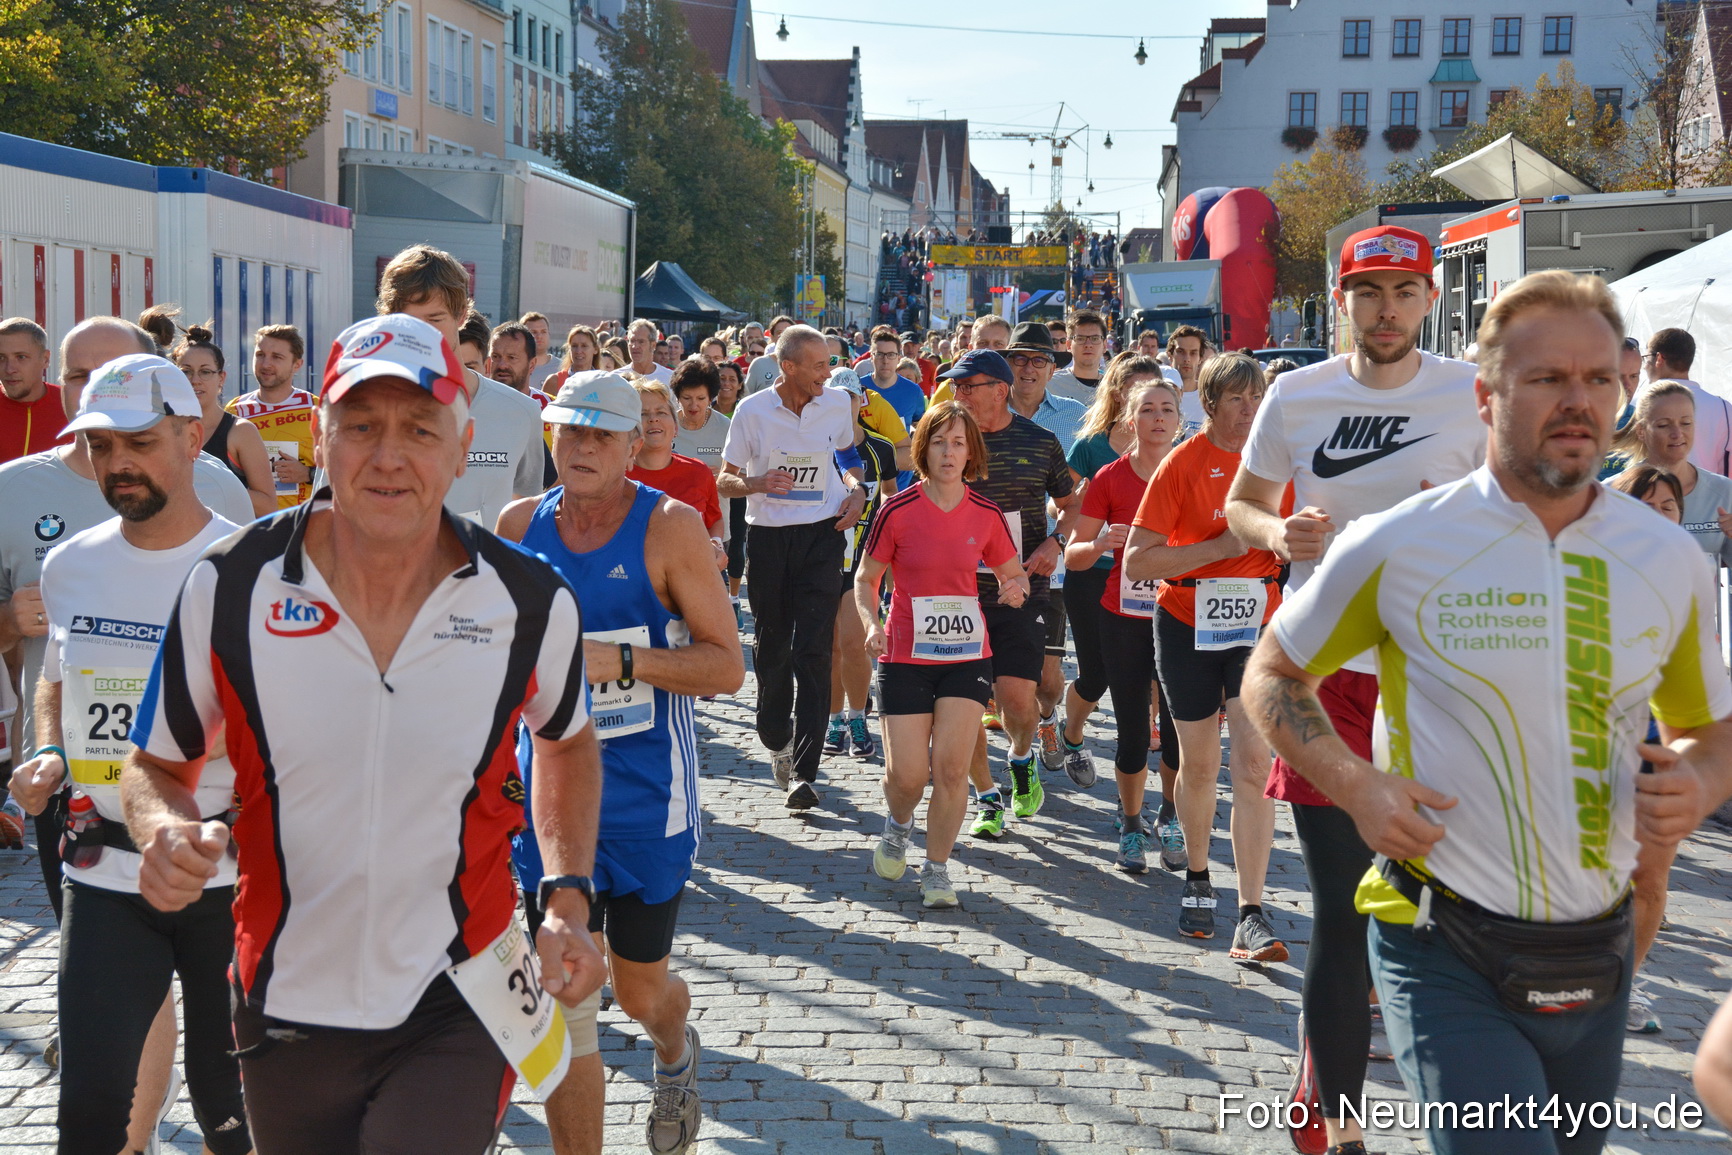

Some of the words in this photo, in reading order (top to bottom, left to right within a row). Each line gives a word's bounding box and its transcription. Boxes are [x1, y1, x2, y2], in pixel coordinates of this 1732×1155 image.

[975, 250, 1022, 260] START
[1151, 284, 1193, 293] BOCK
[1327, 416, 1411, 450] NIKE
[1684, 522, 1720, 532] BOCK
[1218, 584, 1249, 592] BOCK
[1438, 588, 1547, 608] cadion
[270, 598, 319, 622] tkn
[1207, 598, 1257, 620] 2553
[449, 614, 474, 623] team
[1438, 612, 1547, 629] Rothsee
[454, 624, 492, 635] klinikum
[925, 615, 974, 635] 2040
[434, 632, 478, 644] nürnberg
[1213, 630, 1245, 642] Hildegard
[1437, 633, 1549, 650] Triathlon
[934, 646, 963, 654] Andrea
[1561, 551, 1612, 772] FINISHER
[95, 678, 148, 692] BOCK
[86, 747, 111, 755] PARTL
[1527, 988, 1593, 1005] Reebok
[502, 1031, 509, 1040] C
